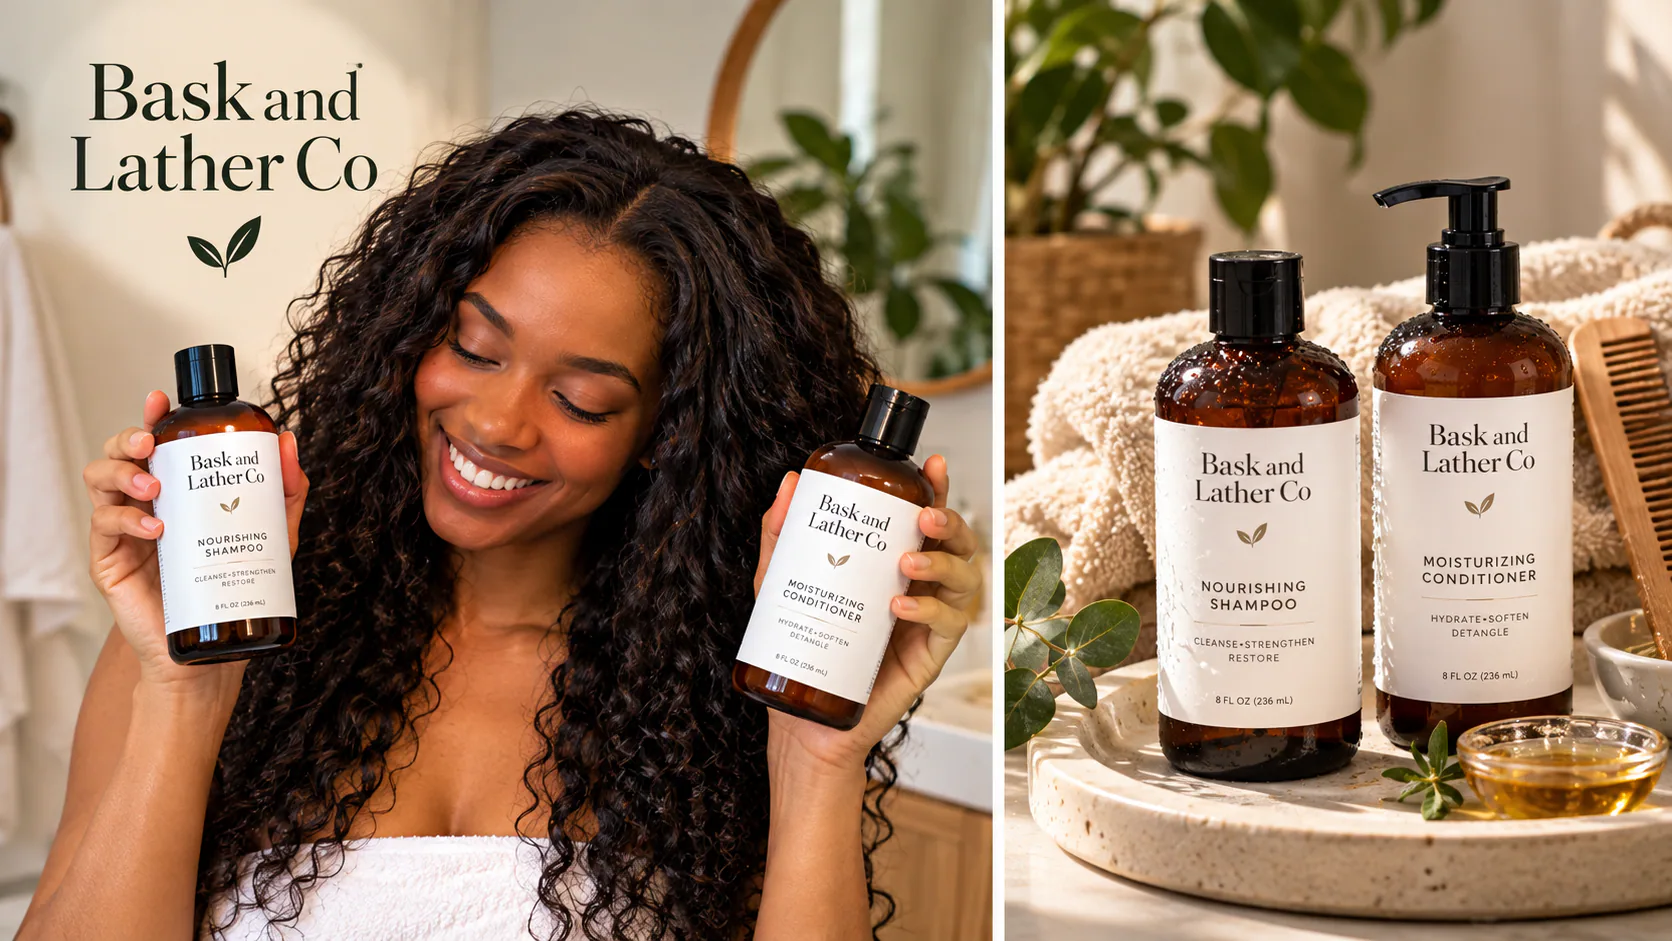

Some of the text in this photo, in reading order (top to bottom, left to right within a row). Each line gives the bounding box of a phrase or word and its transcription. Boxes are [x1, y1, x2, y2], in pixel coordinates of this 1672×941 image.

[1429, 422, 1529, 446] Bask and
[190, 450, 259, 471] Bask and
[1202, 452, 1304, 476] Bask and
[1422, 449, 1536, 473] Lather Co
[187, 468, 265, 491] Lather Co
[1195, 479, 1312, 504] Lather Co
[818, 494, 891, 532] Bask and
[197, 532, 268, 547] NOURISHING
[808, 512, 864, 544] Lather
[865, 531, 887, 552] Co
[205, 543, 264, 558] SHAMPOO
[1423, 553, 1536, 569] MOISTURIZING
[221, 577, 255, 587] RESTORE
[1422, 570, 1537, 585] CONDITIONER
[1201, 580, 1306, 594] NOURISHING
[788, 579, 865, 612] MOISTURIZING
[783, 589, 862, 623] CONDITIONER
[1210, 598, 1297, 611] SHAMPOO
[790, 631, 829, 650] DETANGLE
[1452, 627, 1510, 638] DETANGLE
[781, 654, 789, 663] FL
[790, 657, 800, 667] OZ
[1228, 653, 1280, 663] RESTORE
[1442, 670, 1519, 681] 8 FL OZ (236 mL)
[1215, 696, 1294, 706] 8 FL OZ (236 mL)
